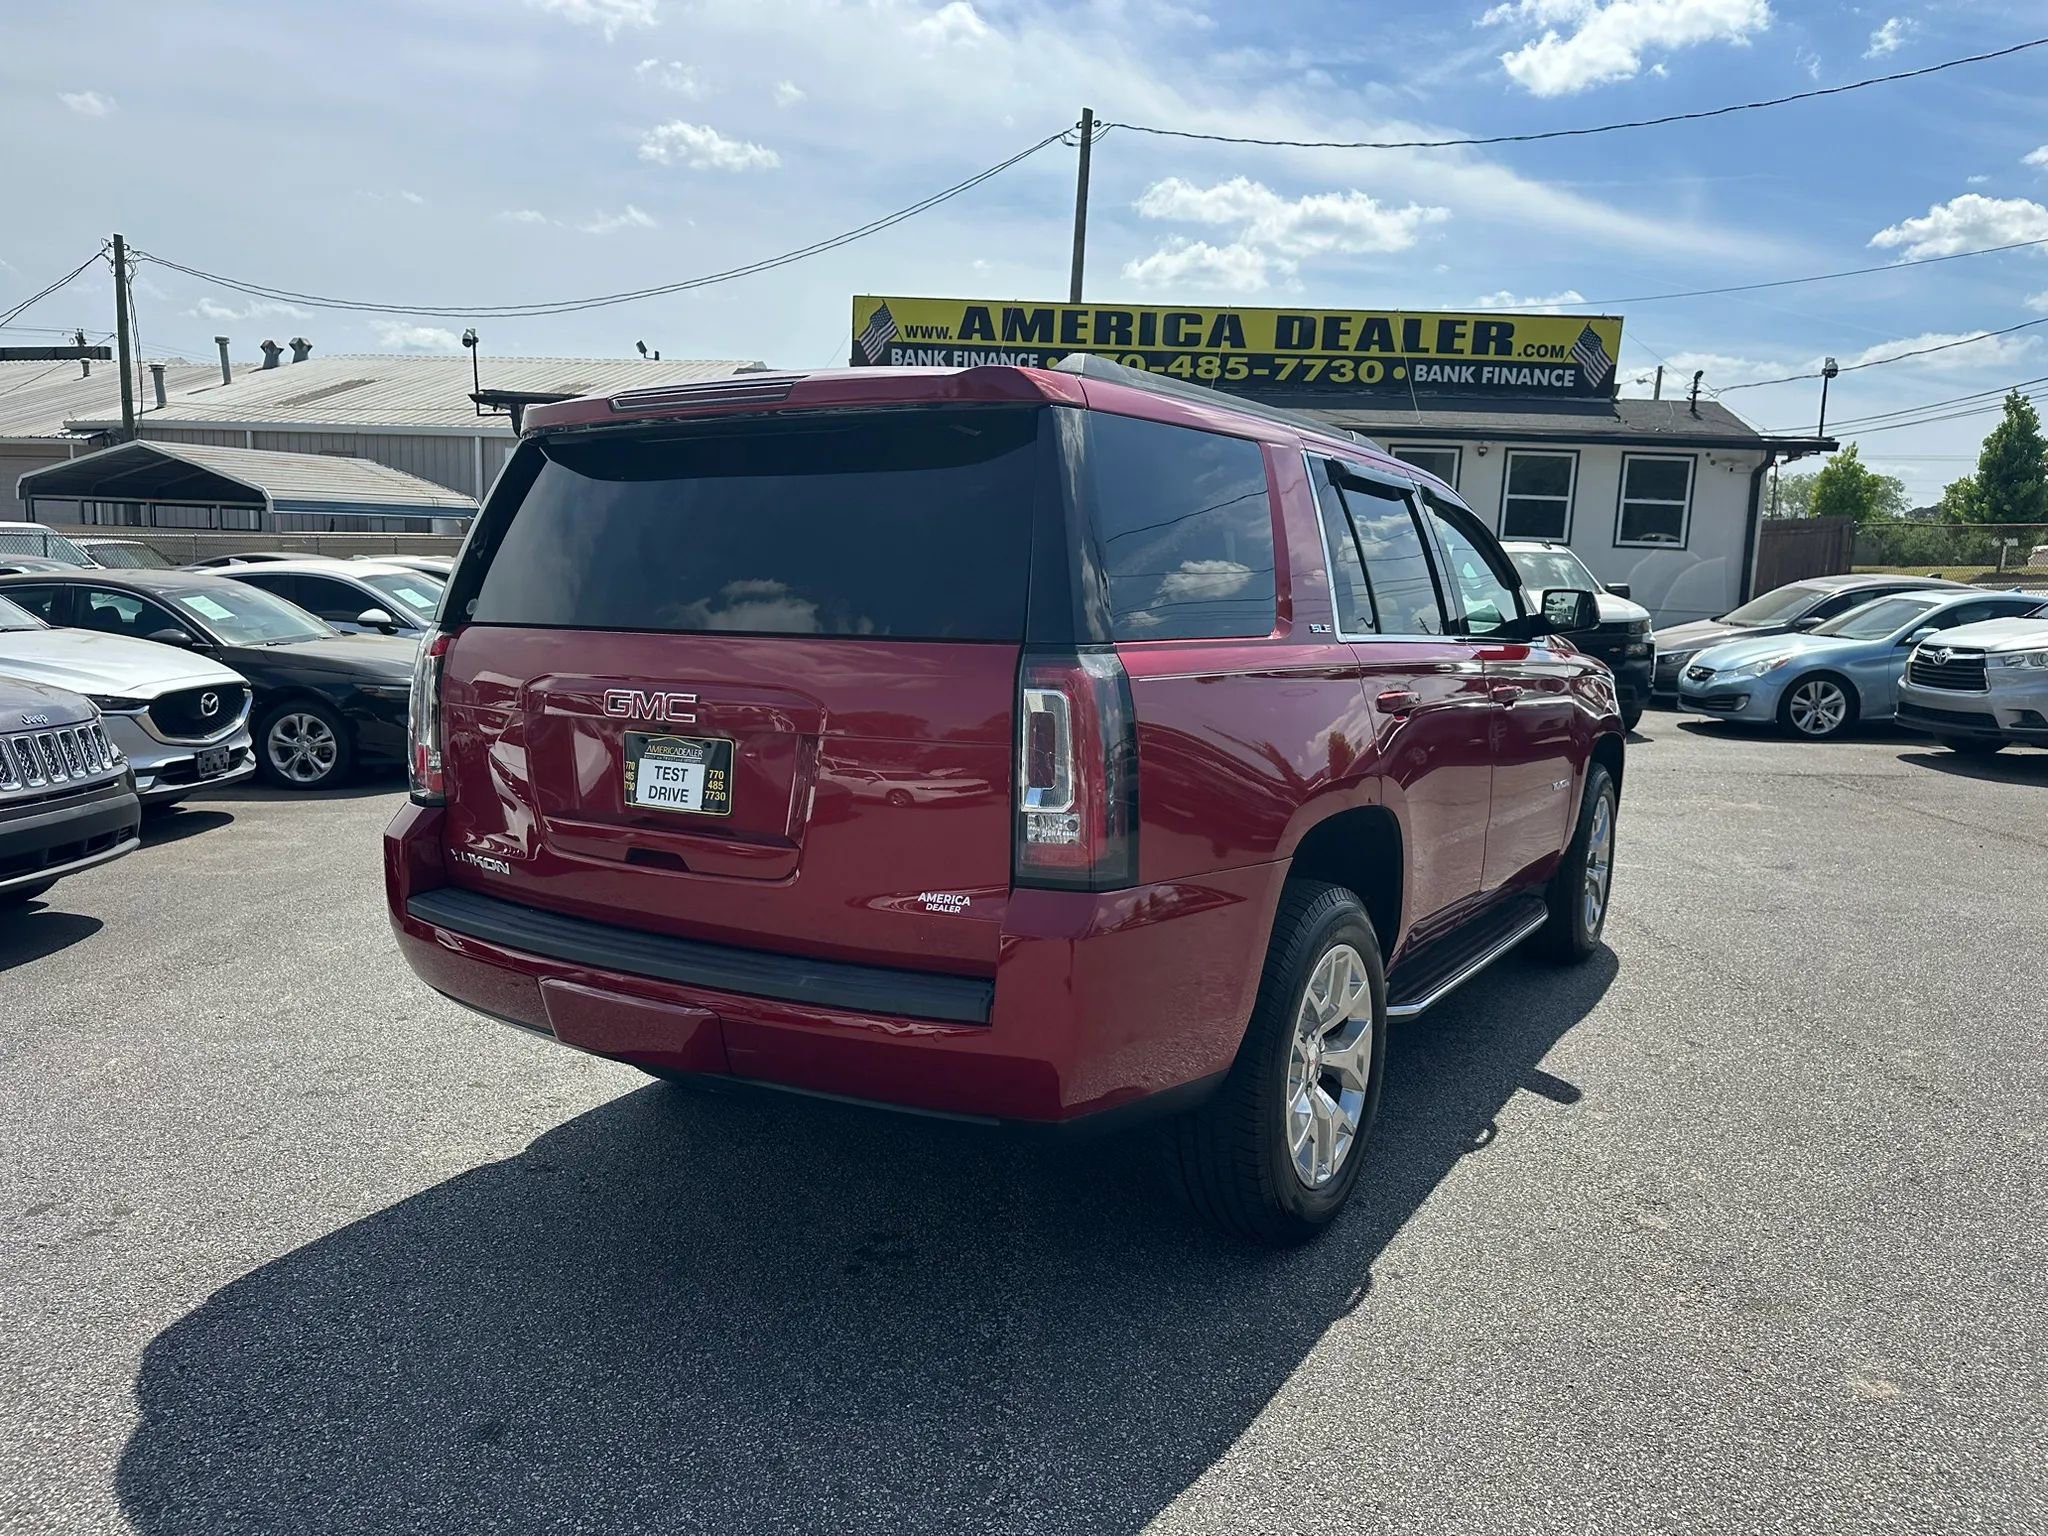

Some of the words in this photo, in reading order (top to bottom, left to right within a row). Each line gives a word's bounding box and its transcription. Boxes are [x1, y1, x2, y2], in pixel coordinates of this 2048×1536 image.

[957, 306, 1246, 348] AMERICA
[1274, 314, 1515, 356] DEALER
[1516, 343, 1565, 359] .COM
[890, 348, 947, 367] BANK
[952, 351, 1039, 368] FINANCE
[1095, 353, 1385, 384] 0-485-7730
[1414, 364, 1475, 383] BANK
[1481, 366, 1575, 387] FINANCE
[1310, 623, 1332, 633] SLE
[603, 689, 697, 723] GMC
[21, 713, 48, 725] Jeep
[654, 765, 688, 783] TEST
[709, 769, 724, 780] 770
[707, 780, 724, 791] 485
[648, 785, 689, 803] DRIVE
[704, 790, 726, 801] 7730
[917, 892, 971, 906] AMERICA
[925, 903, 962, 914] DEALER
